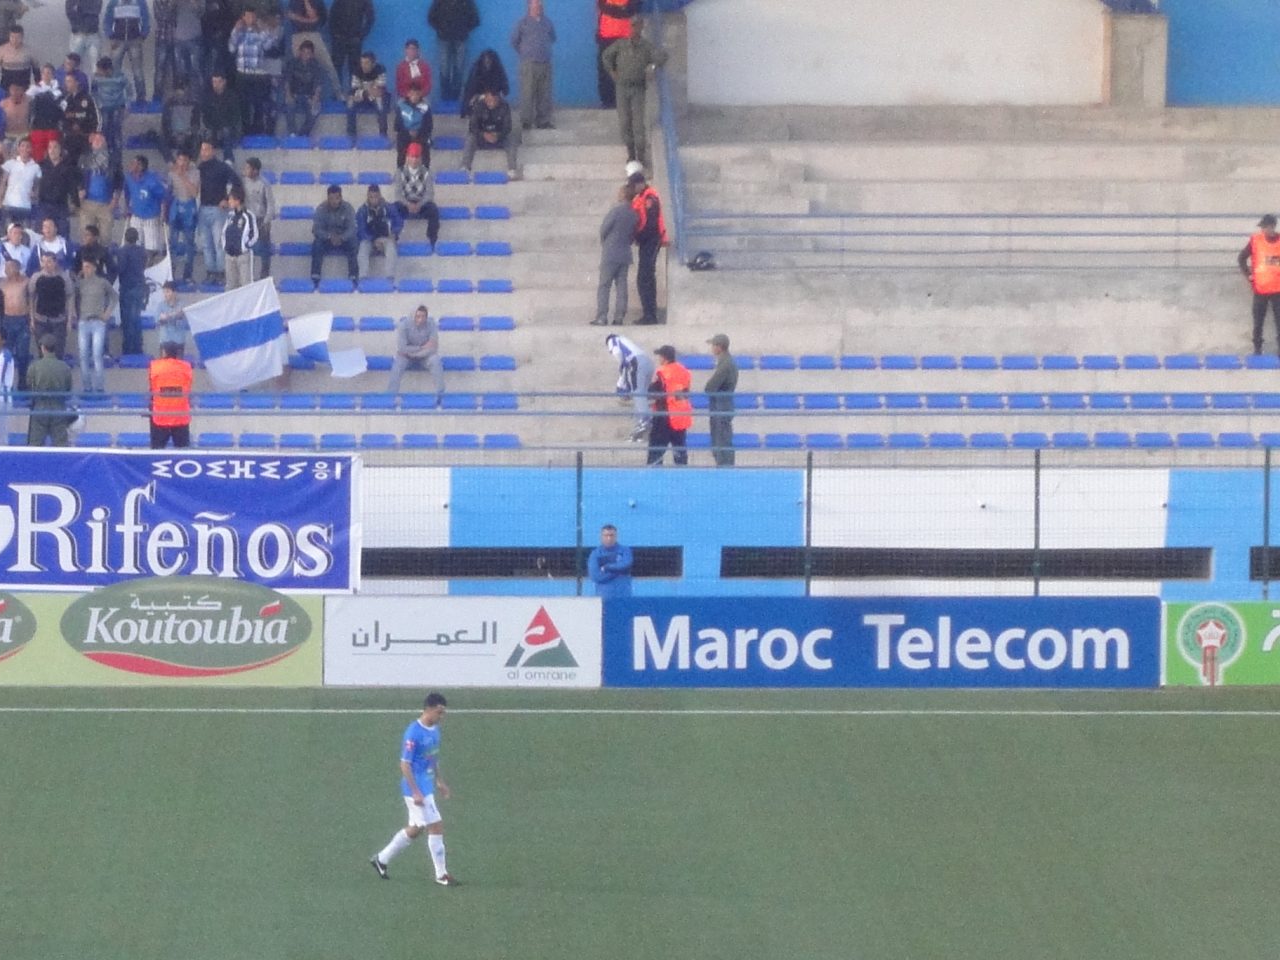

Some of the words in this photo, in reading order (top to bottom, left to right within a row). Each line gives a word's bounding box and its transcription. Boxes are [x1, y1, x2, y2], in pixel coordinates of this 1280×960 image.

[6, 479, 335, 578] Rifeños
[83, 604, 289, 645] Koutoubia
[352, 620, 497, 651] العمران
[632, 614, 833, 671] Maroc
[862, 613, 1130, 671] Telecom
